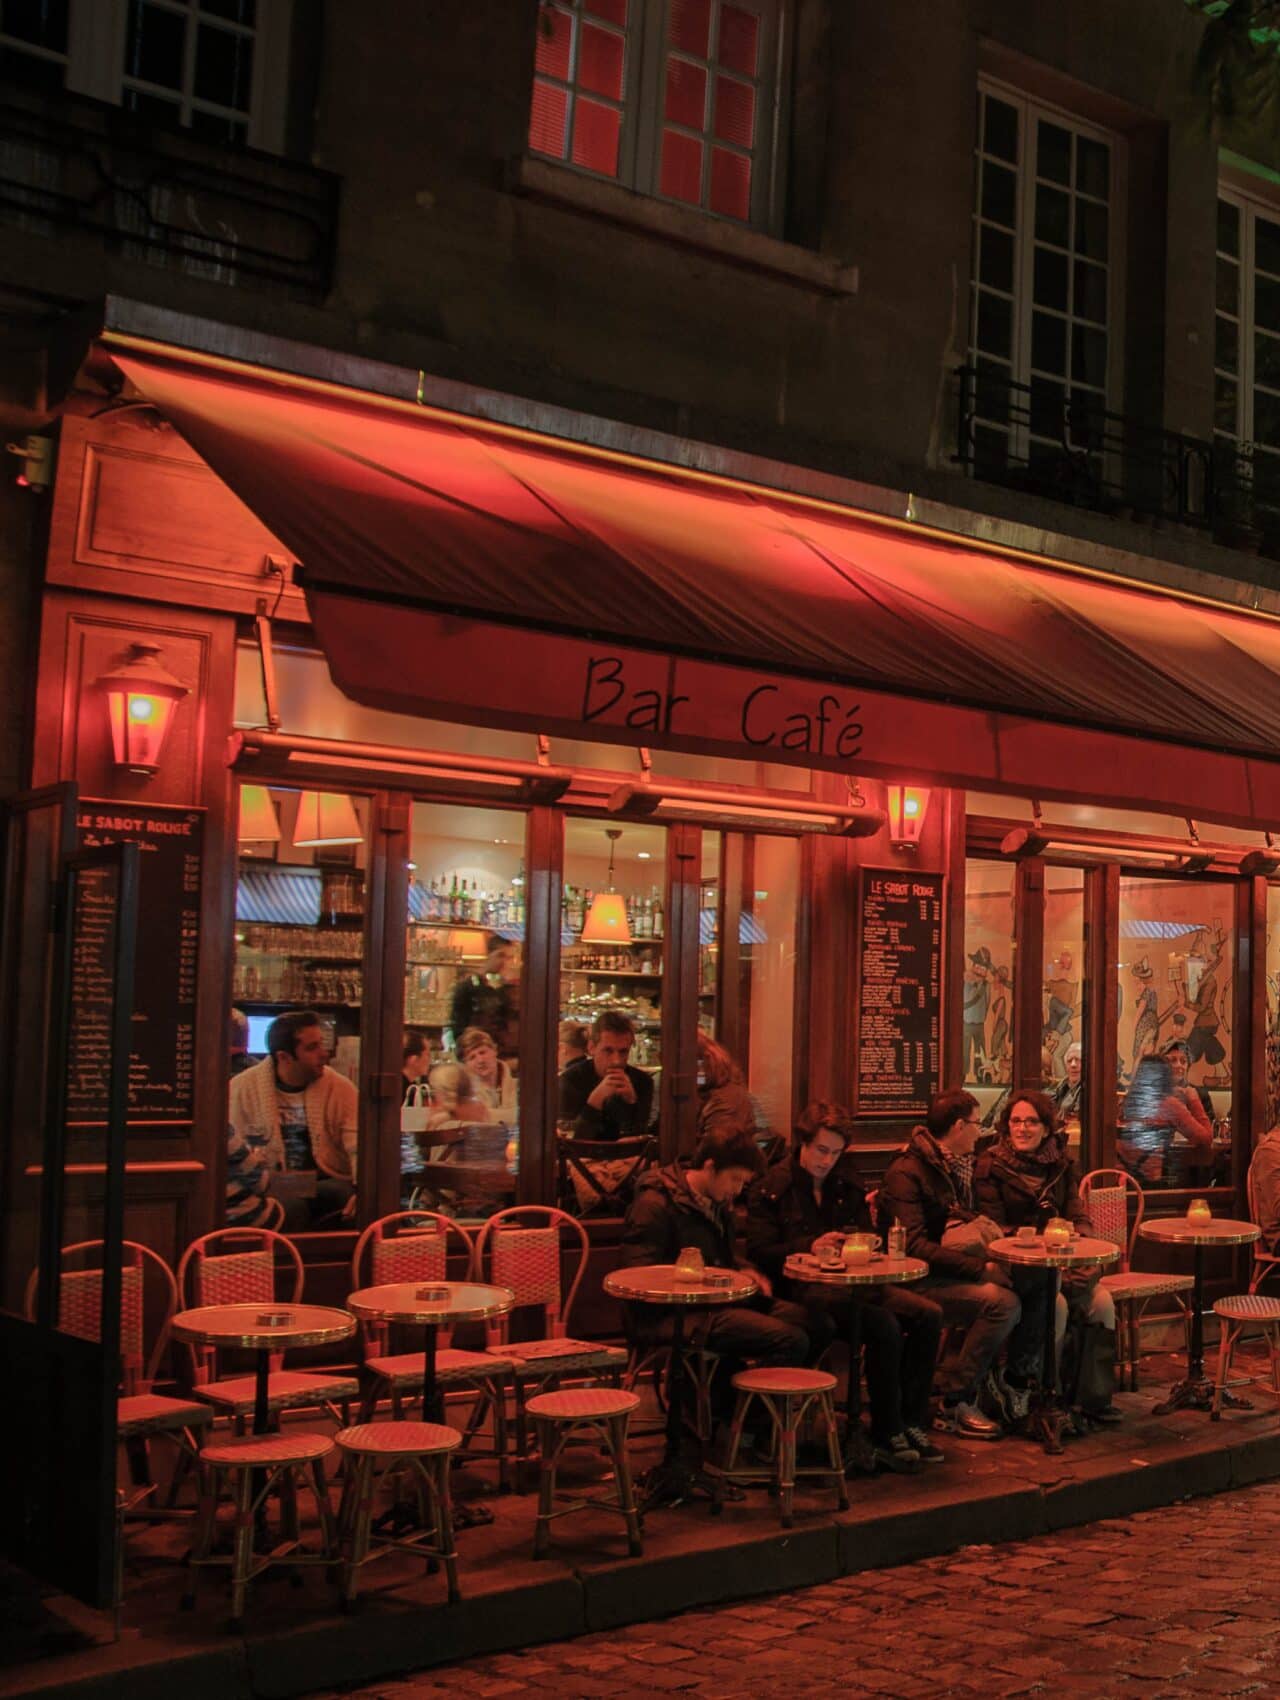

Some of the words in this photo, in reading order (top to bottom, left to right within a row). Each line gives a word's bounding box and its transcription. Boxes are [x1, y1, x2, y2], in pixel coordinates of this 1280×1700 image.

[582, 656, 690, 735] Bar
[741, 684, 864, 759] Café
[76, 815, 92, 828] LE
[95, 816, 144, 832] SABOT
[146, 820, 192, 835] ROUGE
[871, 880, 882, 894] LE
[884, 882, 910, 896] SABOT
[912, 884, 936, 897] ROUGE
